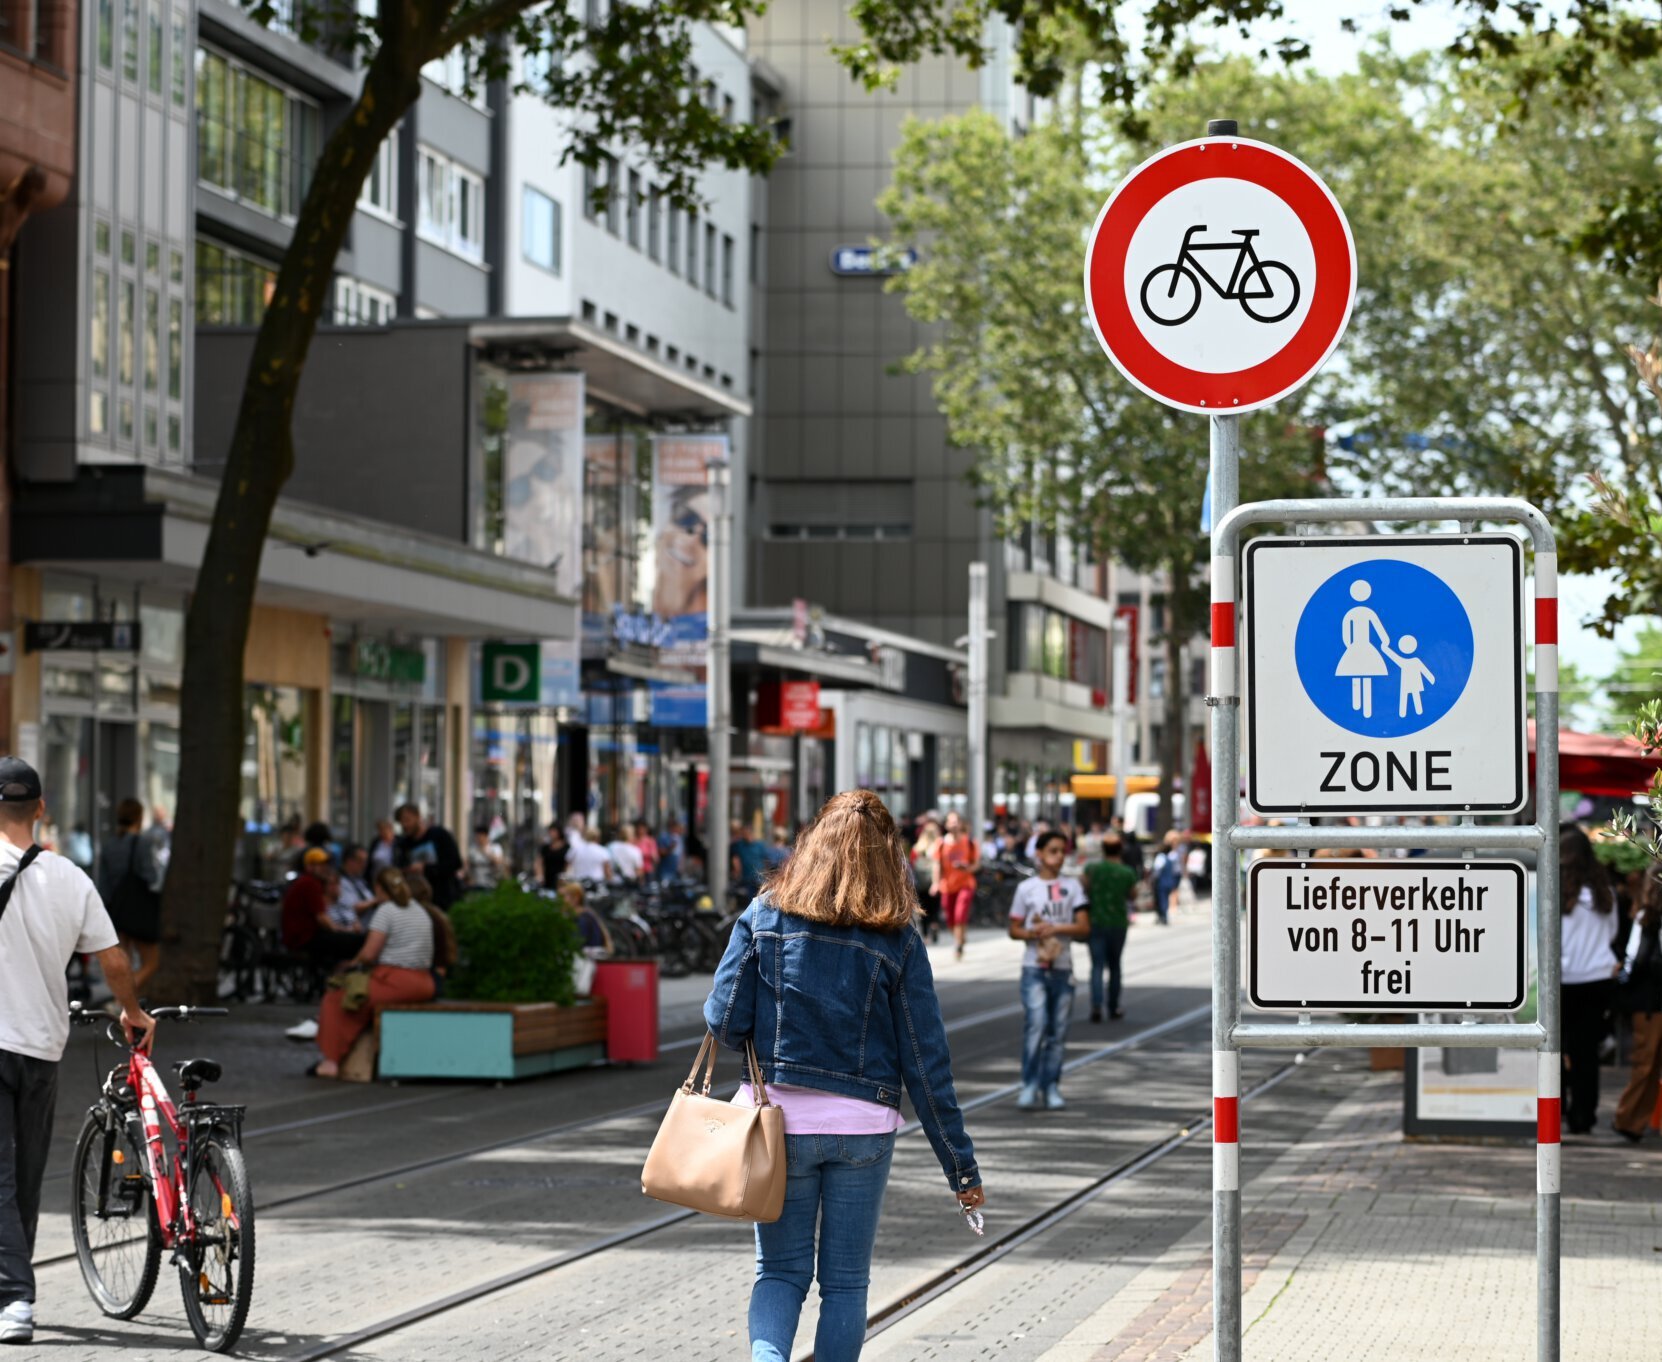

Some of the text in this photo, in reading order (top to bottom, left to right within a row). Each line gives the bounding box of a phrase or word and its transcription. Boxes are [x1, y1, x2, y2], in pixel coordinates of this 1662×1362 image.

[492, 655, 531, 693] D
[1319, 750, 1452, 793] ZONE
[1286, 876, 1489, 911] Lieferverkehr
[1287, 927, 1338, 952] von
[1435, 918, 1486, 953] Uhr
[1360, 960, 1411, 995] frei
